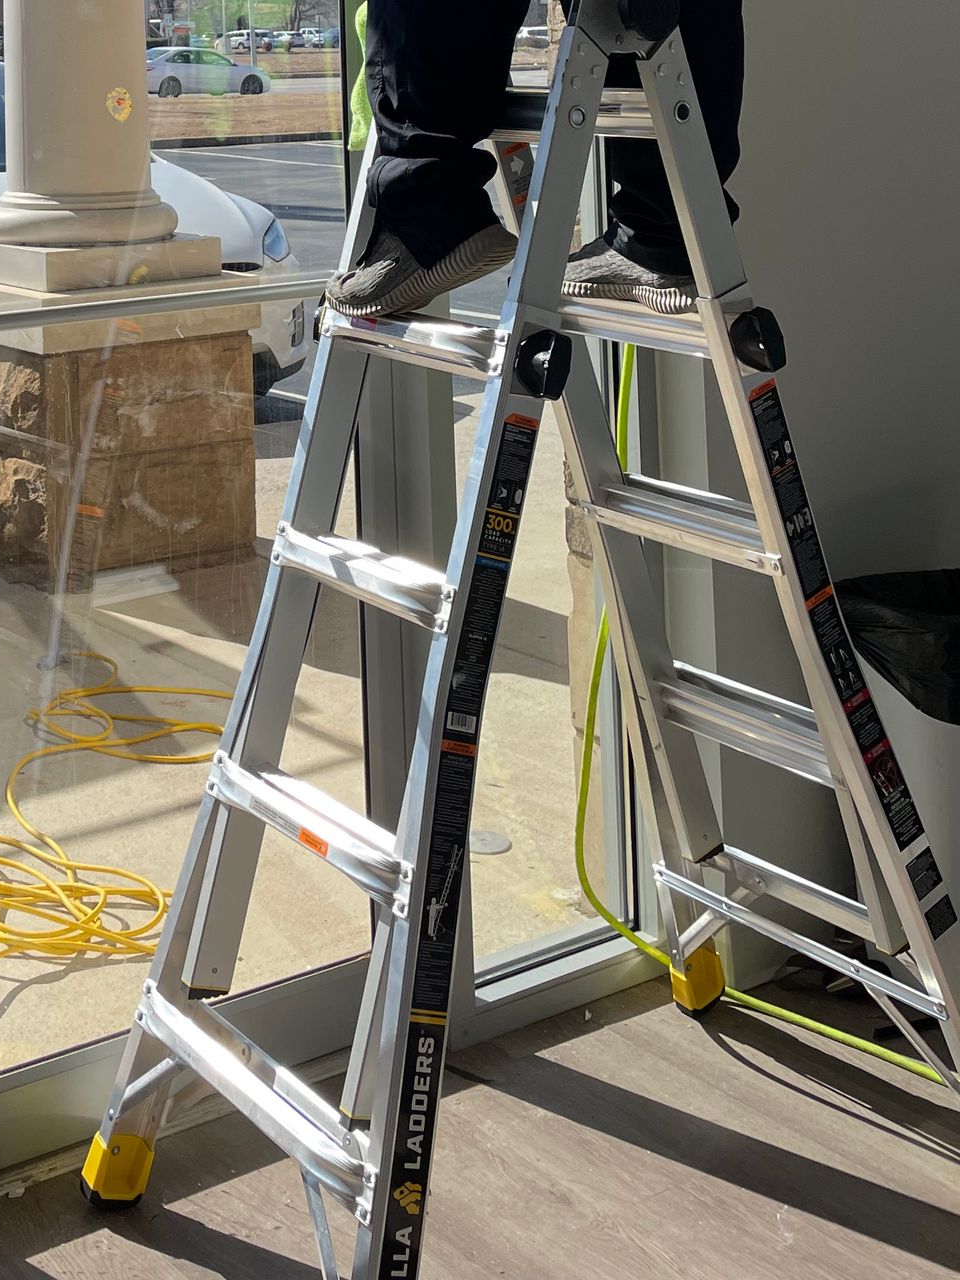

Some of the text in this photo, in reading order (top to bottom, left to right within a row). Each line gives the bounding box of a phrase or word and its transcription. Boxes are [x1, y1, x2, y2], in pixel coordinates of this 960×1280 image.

[486, 513, 513, 533] 300
[404, 1036, 435, 1170] LADDERS
[390, 1226, 413, 1278] LLA
